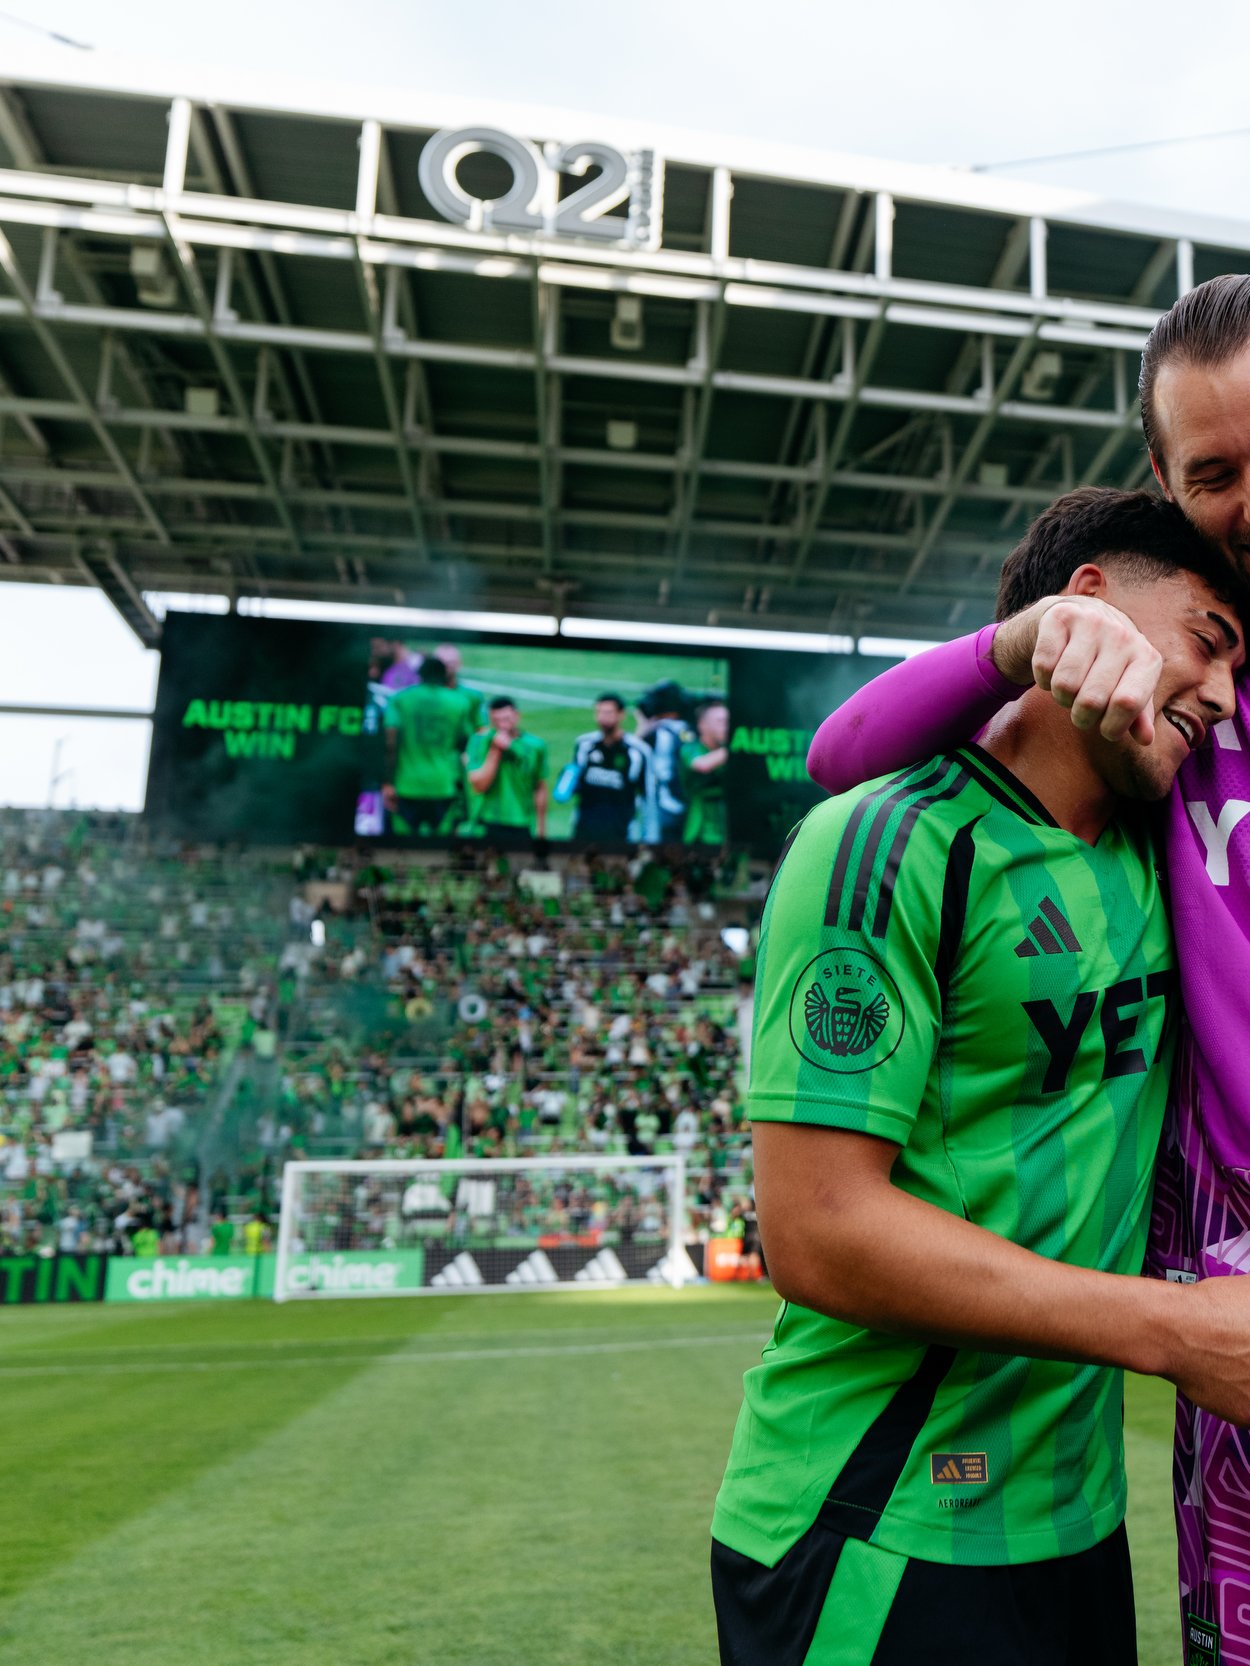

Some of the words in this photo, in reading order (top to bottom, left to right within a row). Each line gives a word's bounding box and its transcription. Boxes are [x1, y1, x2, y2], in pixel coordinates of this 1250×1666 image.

[418, 126, 629, 240] Q2
[182, 699, 312, 734] AUSTIN
[318, 704, 363, 736] FC
[224, 730, 295, 760] WIN
[730, 726, 815, 754] AUST
[823, 964, 876, 987] SIETE
[1020, 967, 1176, 1094] YET
[0, 1256, 98, 1302] TIN
[127, 1257, 246, 1299] chime
[287, 1254, 398, 1290] chime
[1189, 1627, 1214, 1650] AUSTIN
